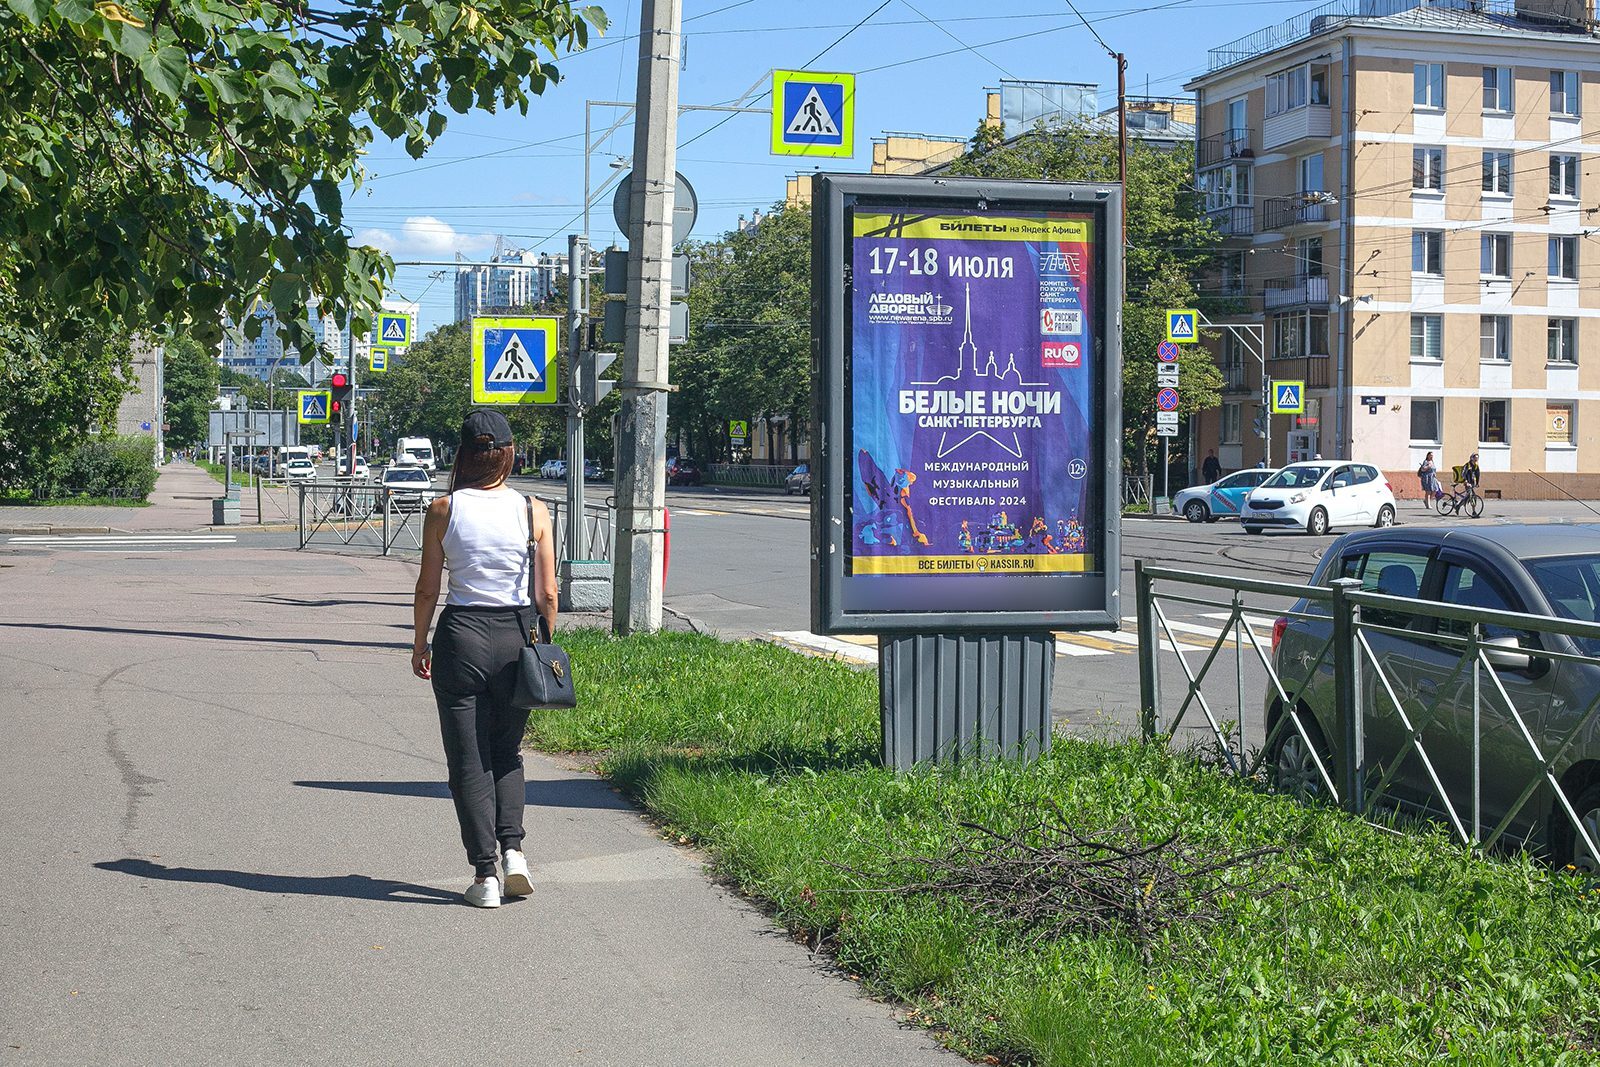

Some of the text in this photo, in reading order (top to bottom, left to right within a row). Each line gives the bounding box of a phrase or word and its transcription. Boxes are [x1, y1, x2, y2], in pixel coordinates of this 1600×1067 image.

[940, 223, 1007, 232] БИЛЕТЫ
[1021, 226, 1051, 234] Яндекс
[1052, 226, 1081, 235] Афише
[869, 246, 1014, 279] 17-18 ИЮЛЯ
[869, 292, 934, 304] ЛЕДОВЫЙ
[869, 304, 926, 314] ДВОРЕЦ
[1054, 312, 1078, 322] РУССКОЕ
[1054, 322, 1073, 332] РАДИО
[1044, 348, 1062, 359] RU
[899, 390, 1061, 414] БЕЛЫЕ НОЧИ
[918, 415, 1042, 429] САНКТ-ПЕТЕРБУРГА
[924, 460, 1030, 473] МЕЖДУНАРОДНЫЙ
[1070, 463, 1085, 475] 12+
[932, 477, 1020, 490] МУЗЫКАЛЬНЫЙ
[928, 495, 1027, 507] ФЕСТИВАЛЬ 2024
[918, 558, 975, 570] ВСЕ БИЛЕТЫ
[990, 558, 1035, 570] KASSIR.RU
